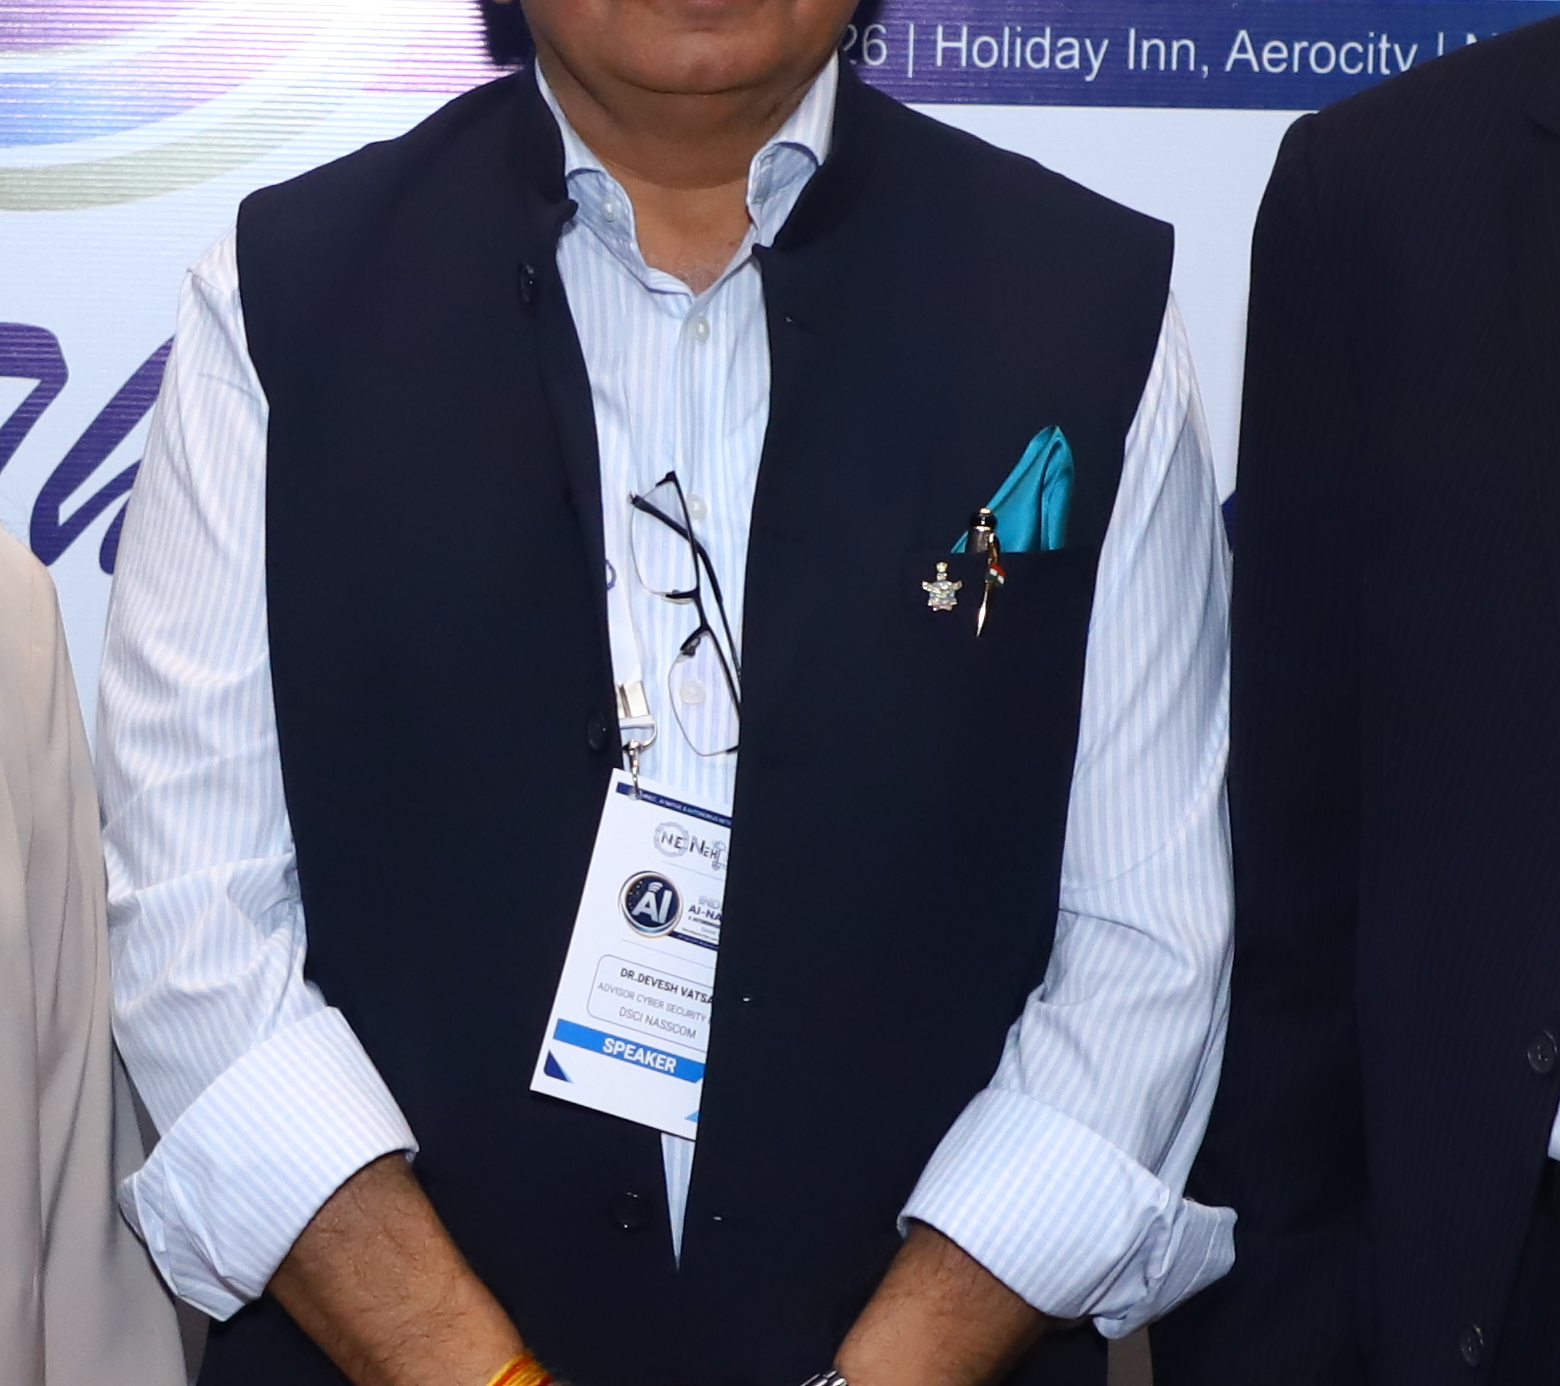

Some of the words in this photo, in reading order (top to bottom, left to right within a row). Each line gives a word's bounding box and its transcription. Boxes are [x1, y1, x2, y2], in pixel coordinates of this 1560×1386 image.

[935, 23, 1110, 82] Holiday
[1129, 26, 1210, 75] Inn,
[1225, 26, 1418, 76] Aerocity
[632, 889, 673, 924] AI
[597, 982, 635, 1001] ADVISOR
[636, 993, 664, 1009] CYBER
[665, 1002, 707, 1023] SECURITY
[618, 1006, 644, 1023] DSCI
[645, 1014, 697, 1039] NASSCOM
[602, 1037, 678, 1074] SPEAKER
